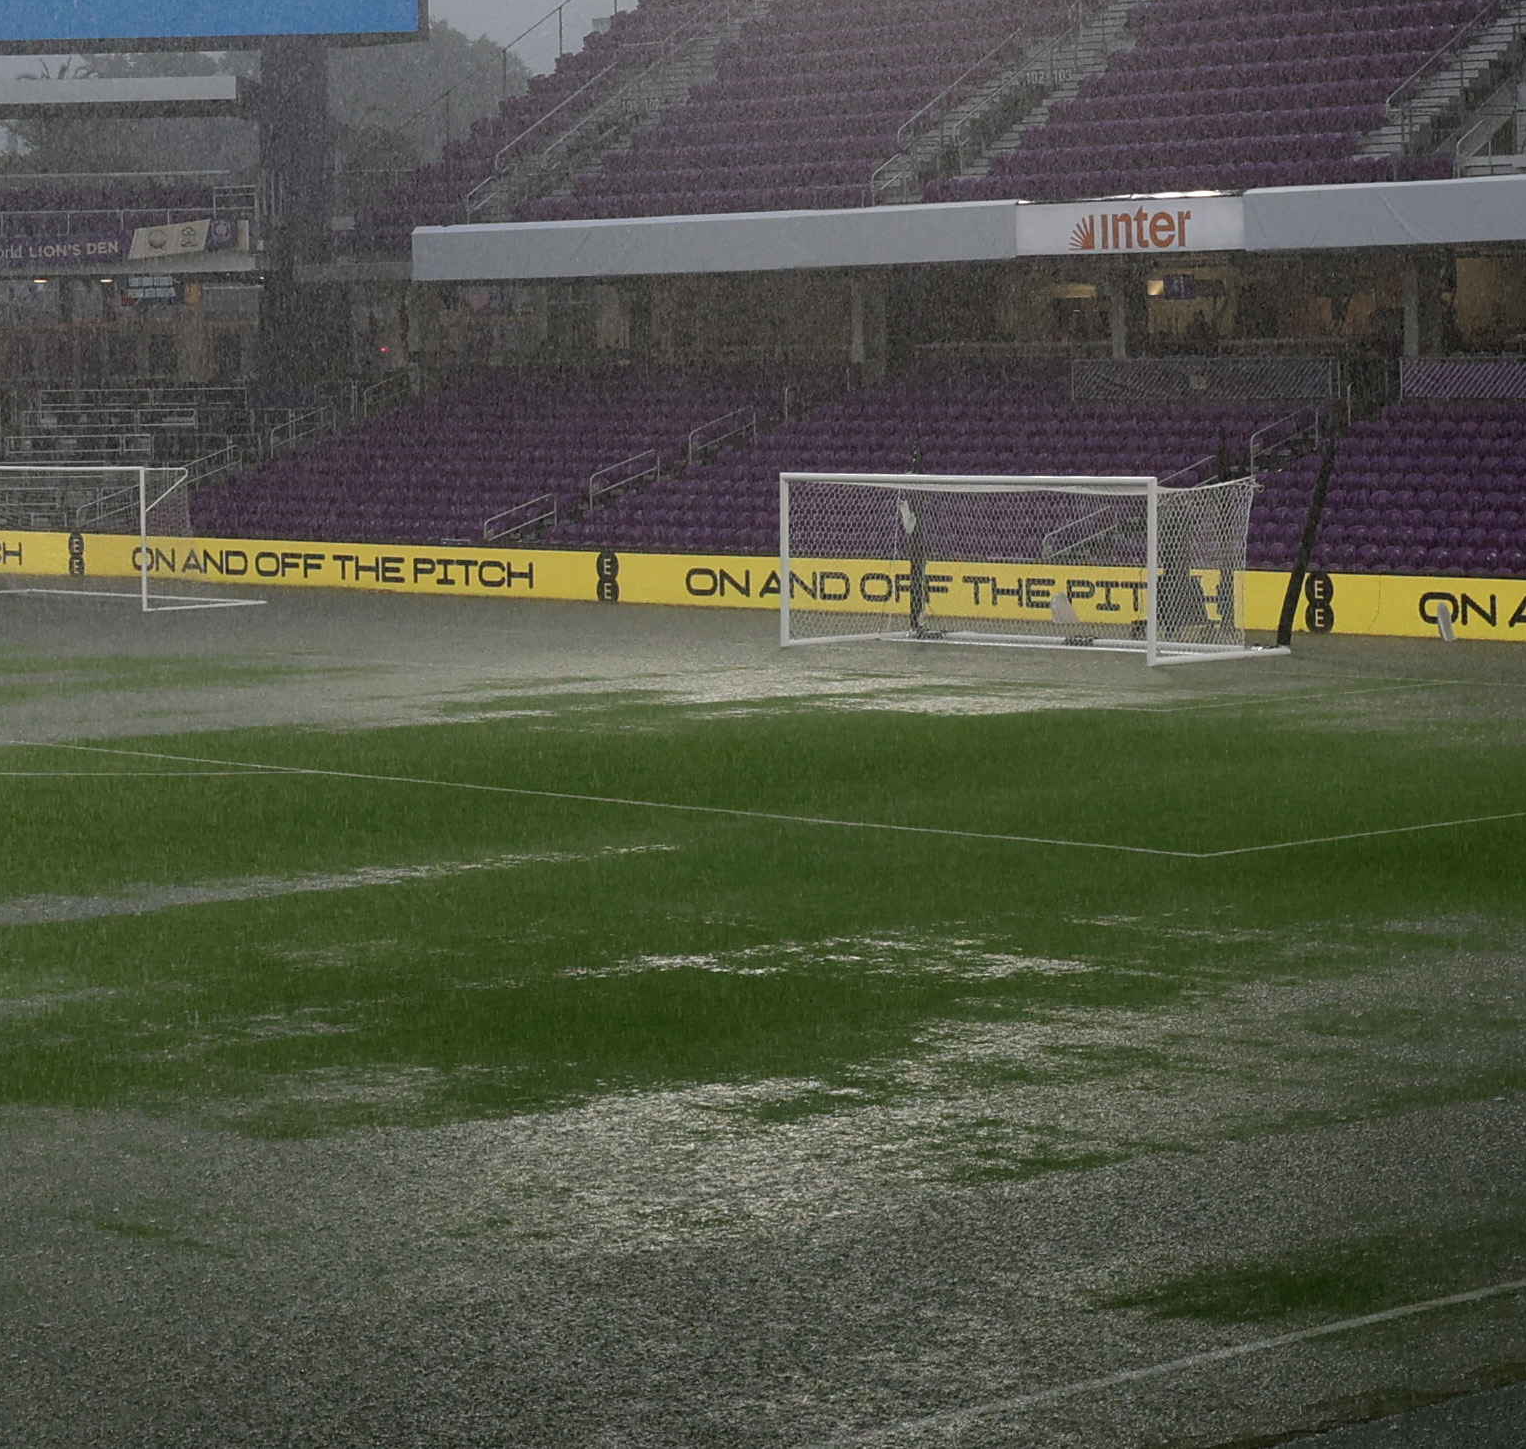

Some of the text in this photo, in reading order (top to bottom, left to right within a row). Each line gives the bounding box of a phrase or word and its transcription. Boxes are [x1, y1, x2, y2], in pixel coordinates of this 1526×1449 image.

[1052, 68, 1072, 86] 103
[1100, 204, 1192, 250] inter
[28, 243, 81, 259] LION'S
[86, 240, 119, 255] DEN
[131, 546, 534, 589] ON AND OFF THE PITCH
[685, 568, 751, 598] ON
[759, 569, 851, 601] AND
[962, 576, 1057, 610] THE
[1419, 591, 1497, 628] ON
